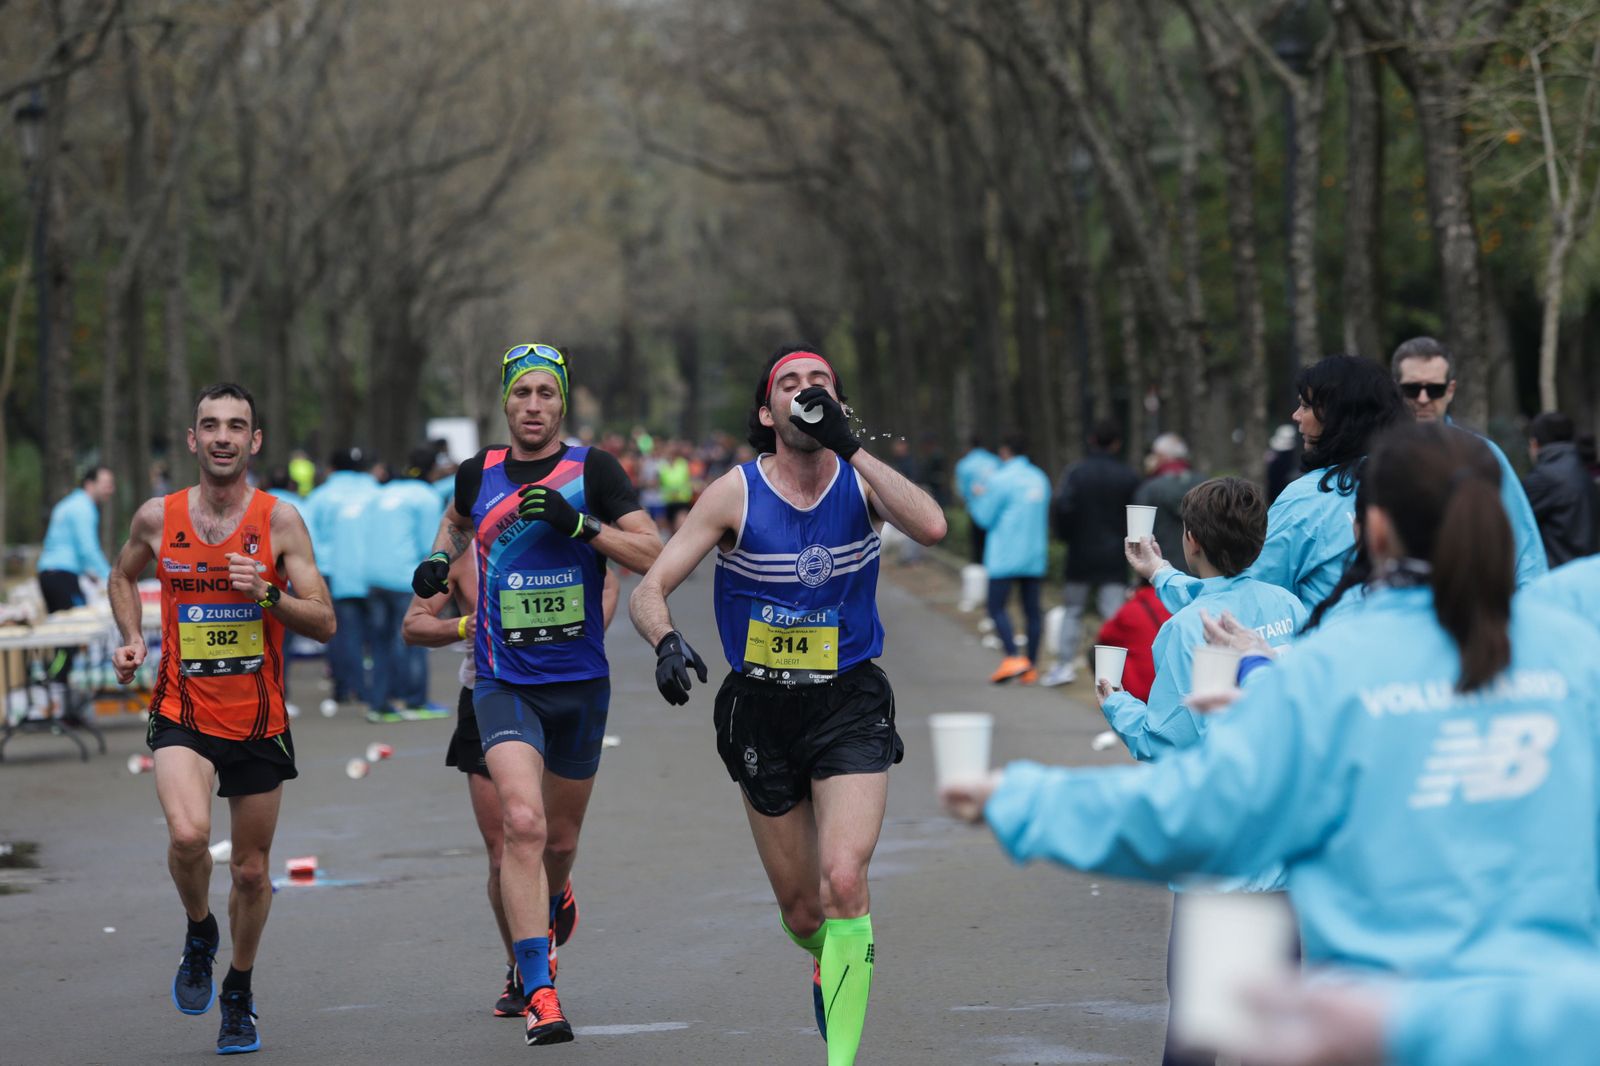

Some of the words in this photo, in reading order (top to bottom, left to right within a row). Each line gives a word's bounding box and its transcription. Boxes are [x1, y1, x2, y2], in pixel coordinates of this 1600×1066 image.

[526, 572, 573, 586] ZURICH
[206, 609, 253, 619] ZURICH
[521, 596, 566, 614] 1123
[775, 612, 827, 626] ZURICH
[1255, 618, 1294, 640] TARIO
[206, 630, 239, 647] 382
[771, 636, 809, 654] 314
[1361, 670, 1569, 717] VOLUARIO
[1406, 712, 1560, 811] NB
